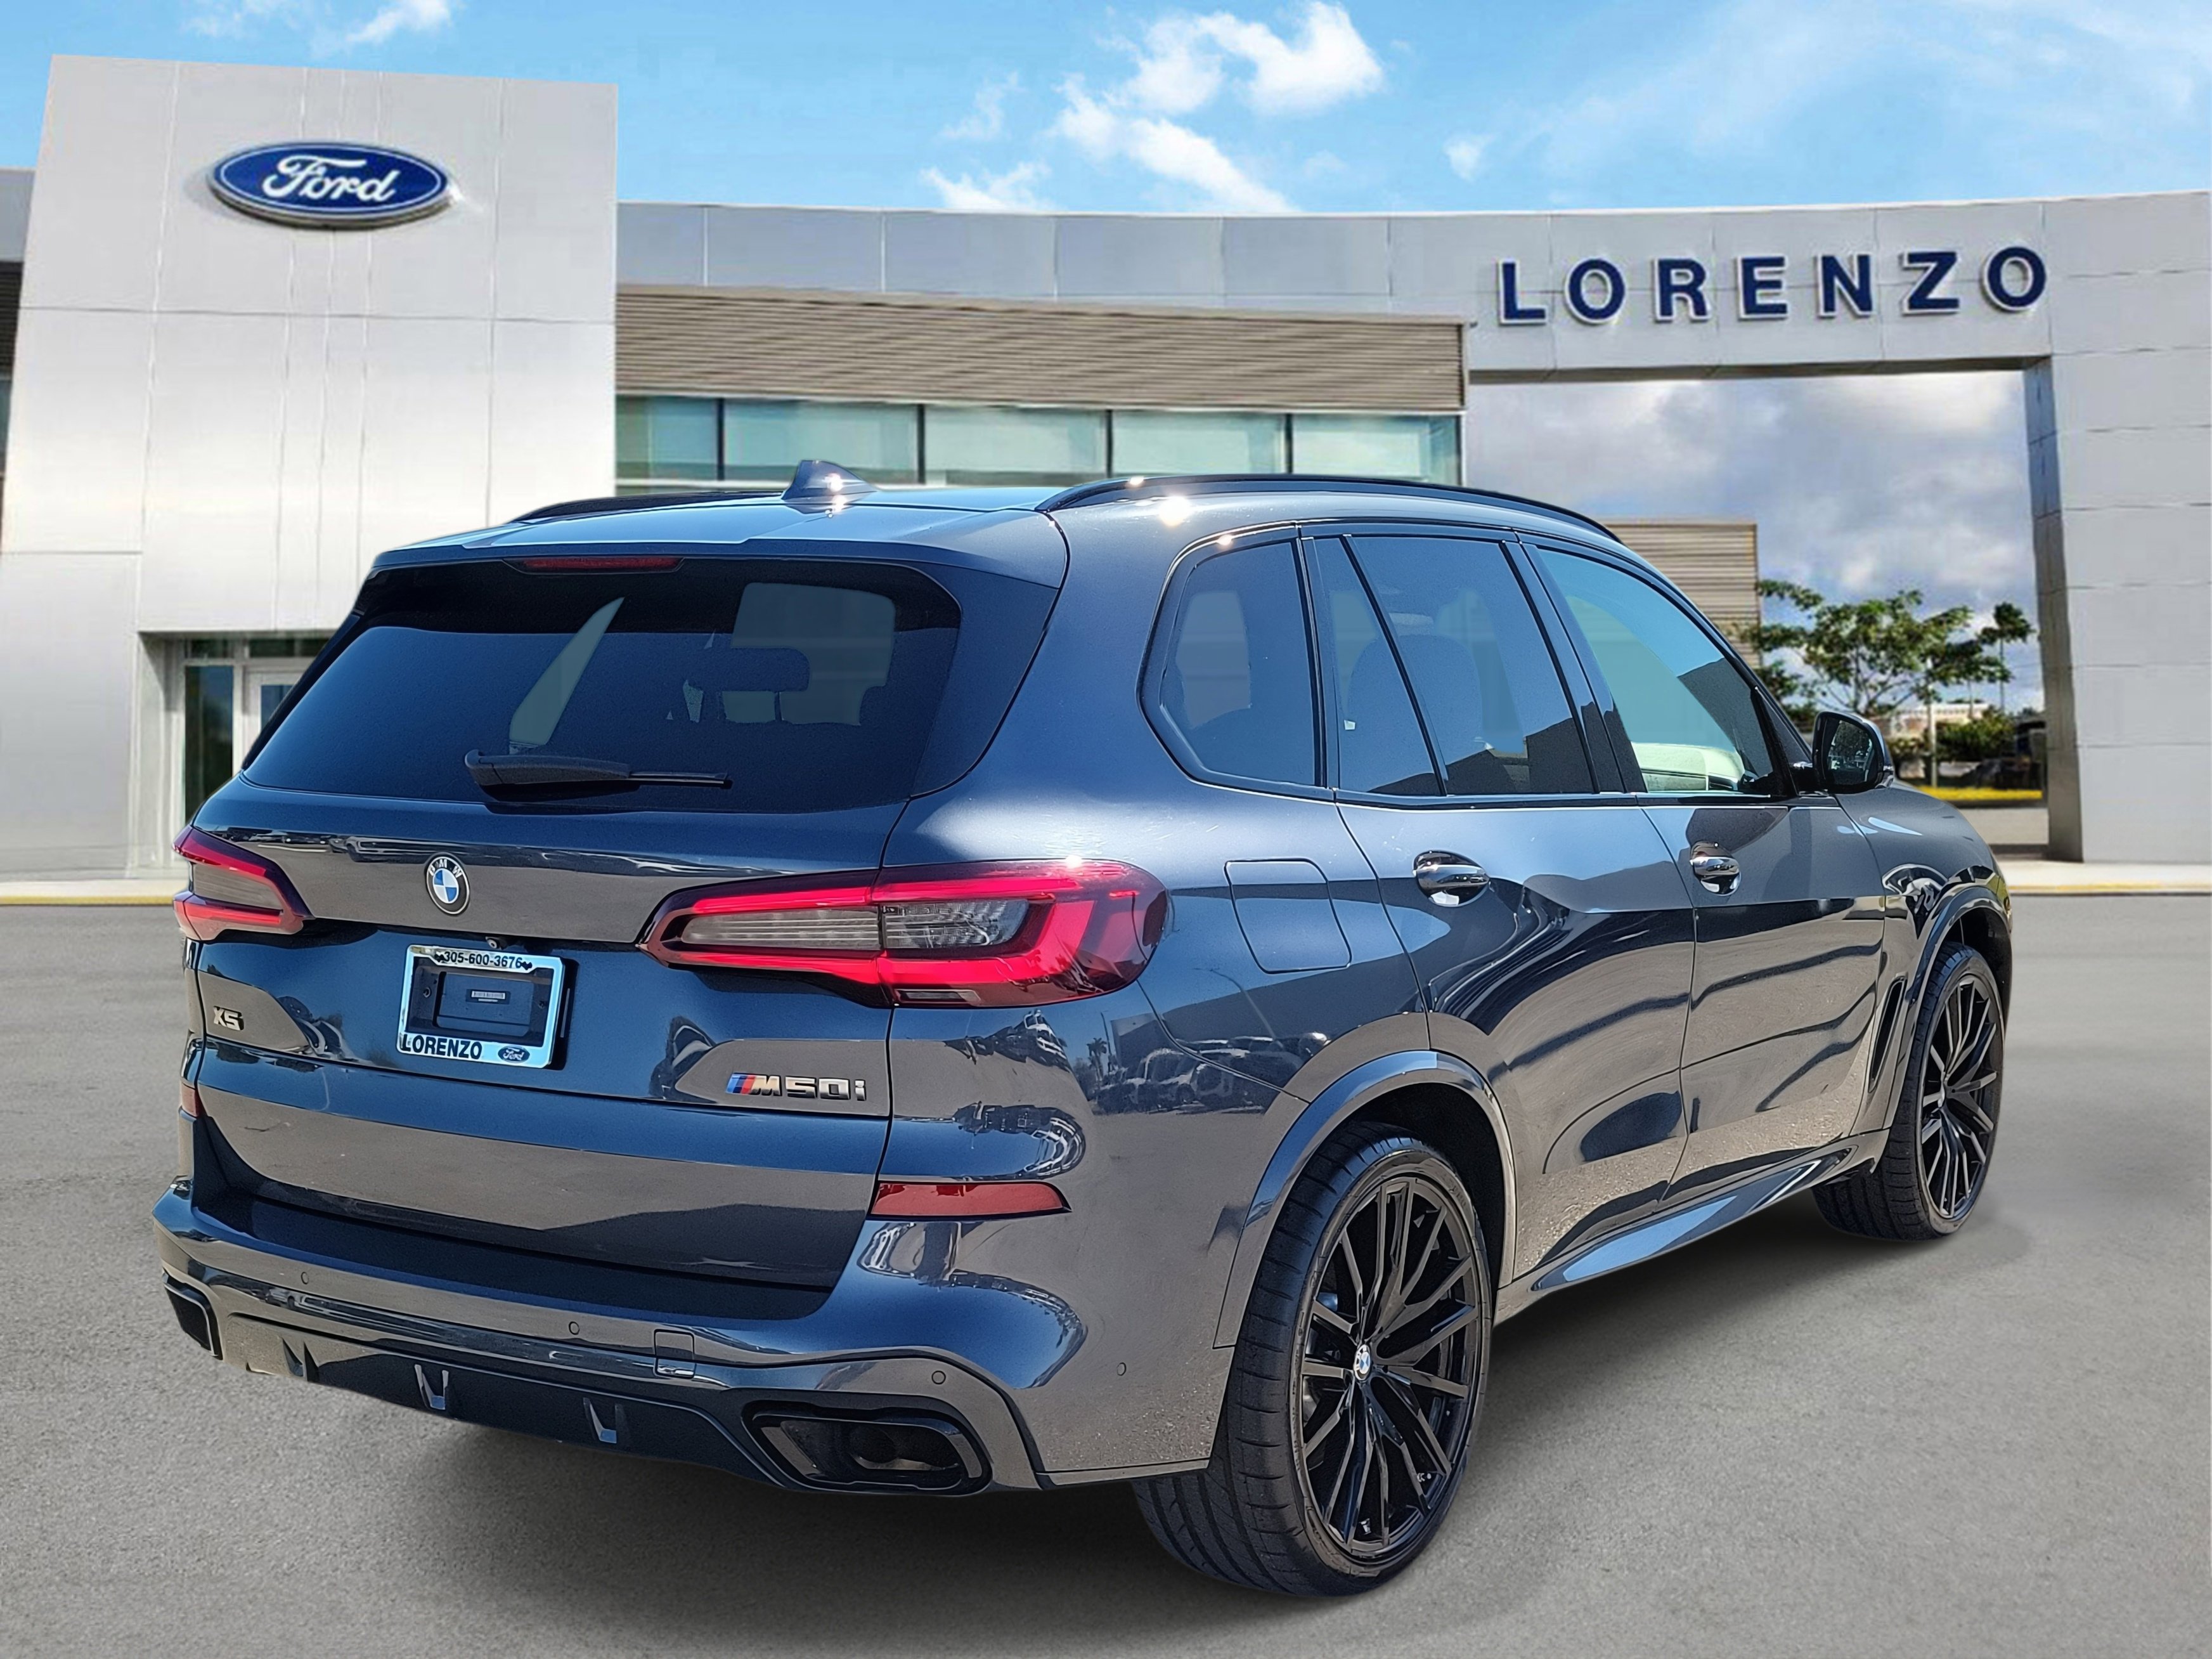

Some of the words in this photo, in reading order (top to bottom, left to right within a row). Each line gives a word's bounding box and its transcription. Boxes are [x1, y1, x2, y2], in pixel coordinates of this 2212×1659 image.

[262, 155, 400, 202] Ford
[1497, 246, 2048, 323] LORENZO
[444, 951, 522, 969] 305-600-3676
[214, 1006, 243, 1031] X5
[402, 1034, 482, 1059] LORENZO
[503, 1048, 525, 1062] Ford
[746, 1074, 866, 1101] M50i
